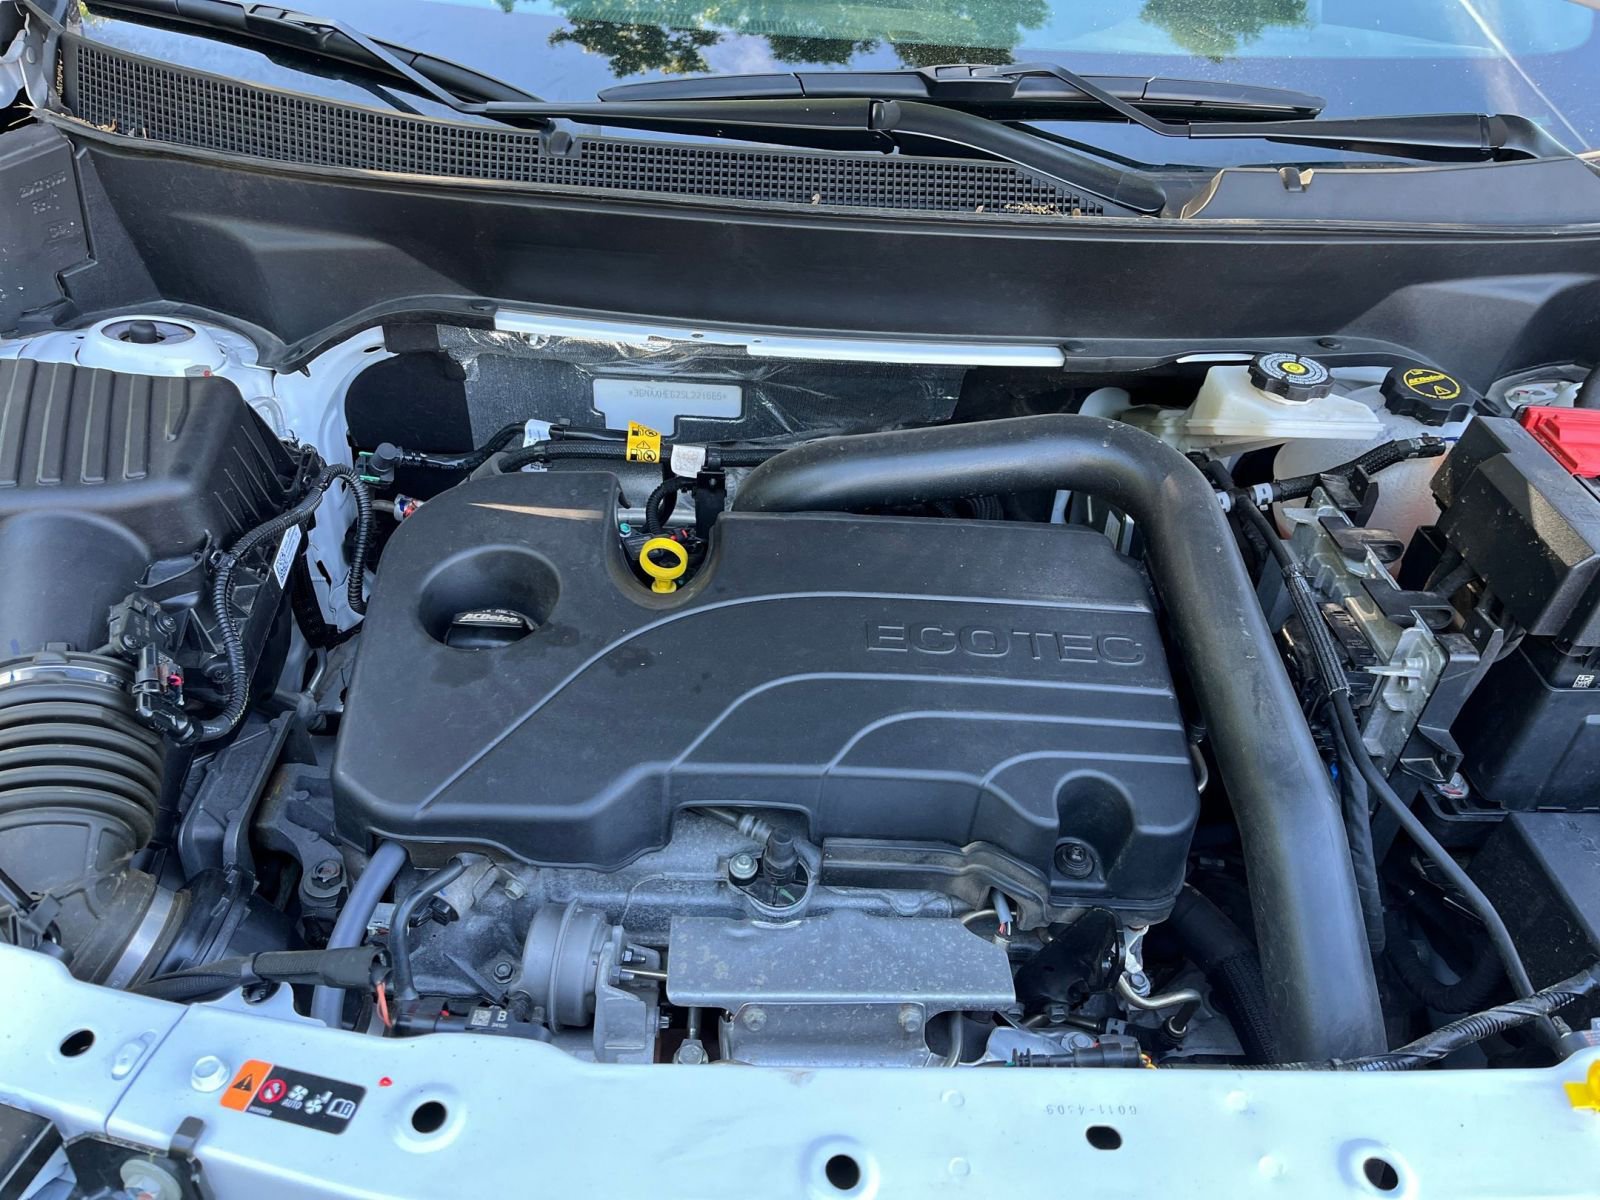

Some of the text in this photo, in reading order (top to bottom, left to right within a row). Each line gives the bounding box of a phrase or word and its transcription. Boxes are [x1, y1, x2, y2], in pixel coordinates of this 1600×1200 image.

[462, 613, 519, 623] ACDelco
[867, 622, 1146, 666] ECOTEC
[497, 1010, 508, 1022] B
[281, 1098, 303, 1110] AUTO
